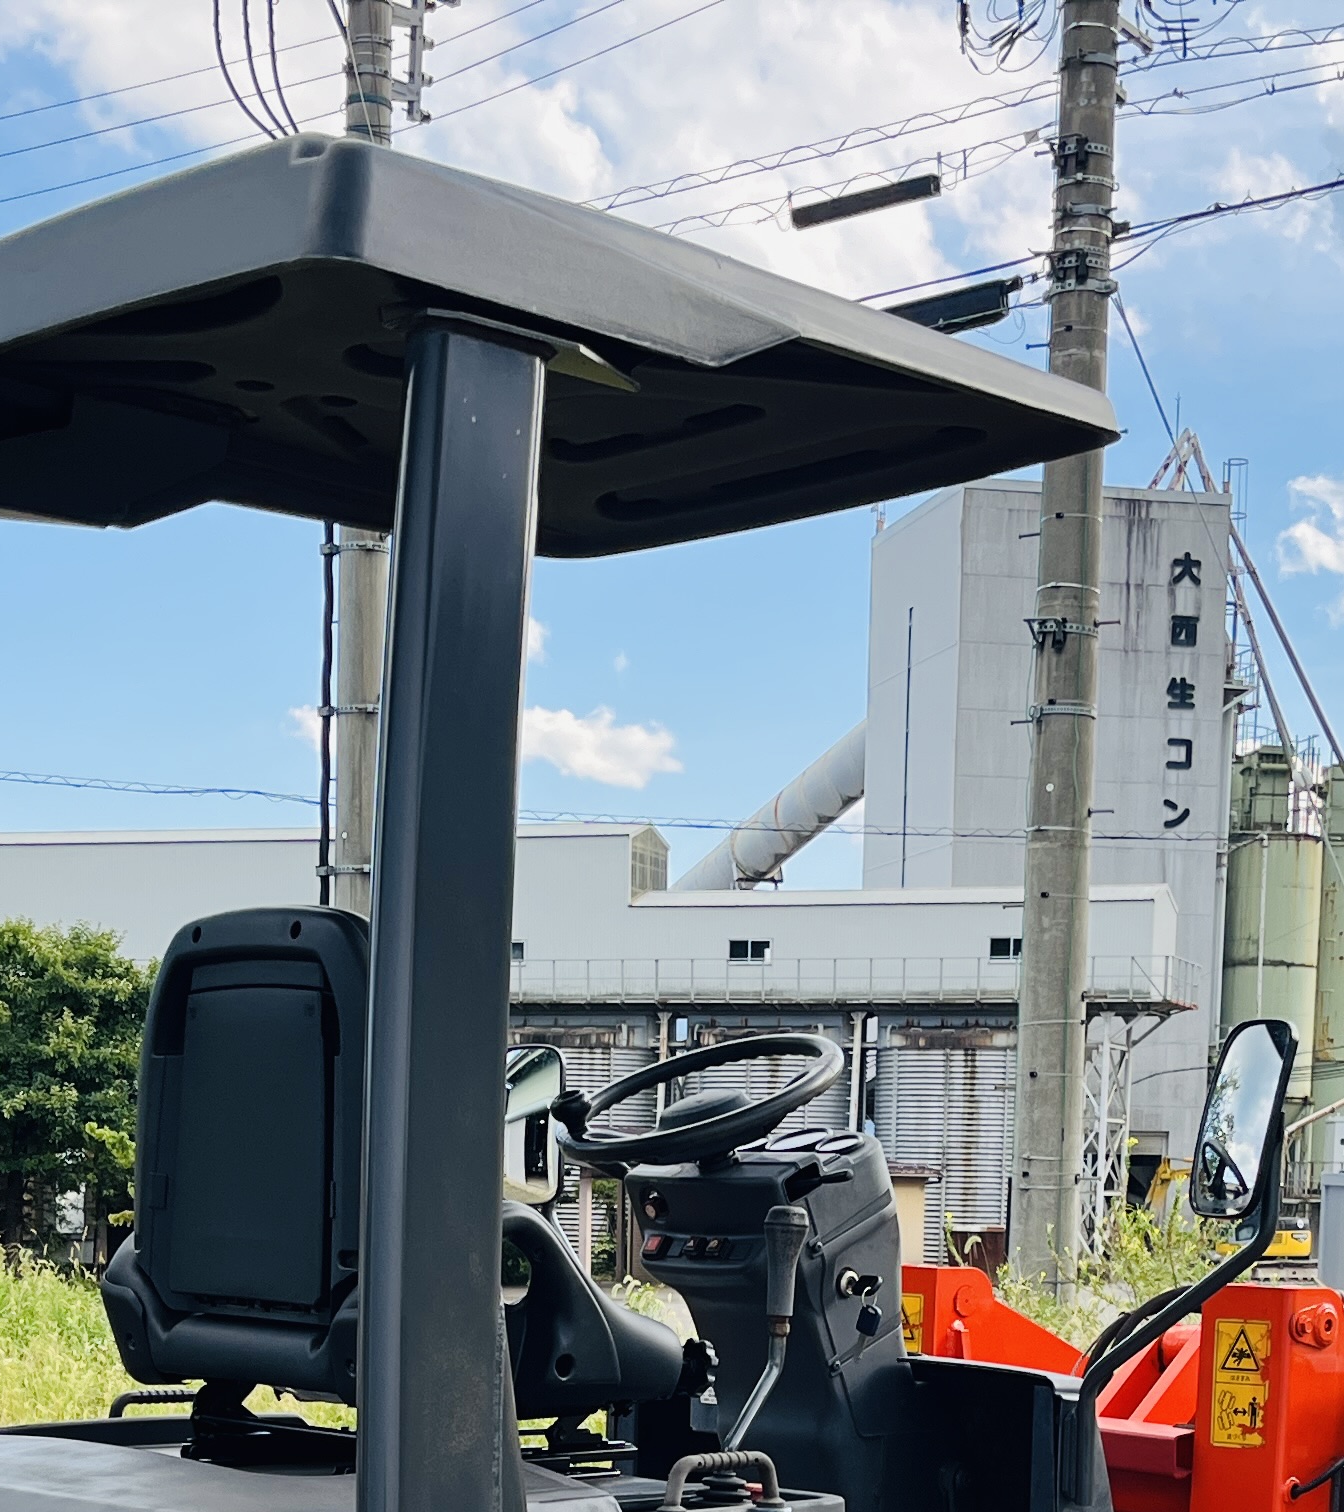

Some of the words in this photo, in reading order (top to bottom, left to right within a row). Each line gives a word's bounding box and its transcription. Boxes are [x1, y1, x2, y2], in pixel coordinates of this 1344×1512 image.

[1163, 551, 1202, 829] 大西生コン
